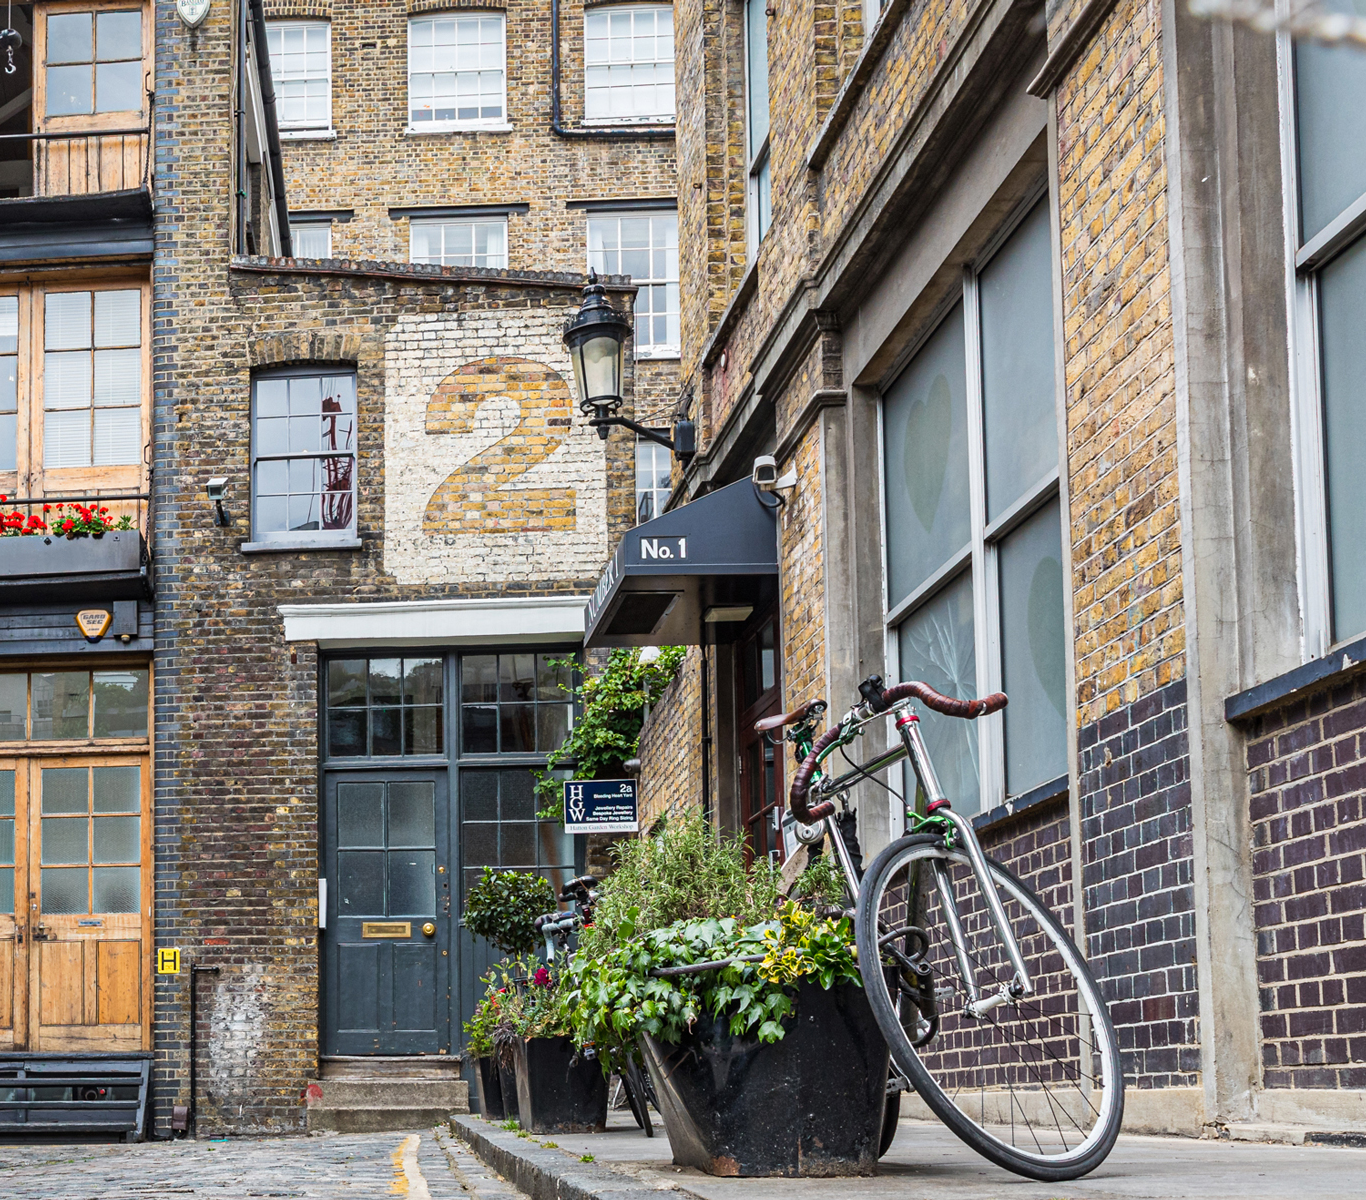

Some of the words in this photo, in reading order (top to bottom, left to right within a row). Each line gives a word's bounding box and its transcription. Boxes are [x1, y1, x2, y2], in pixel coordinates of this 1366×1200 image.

[422, 357, 577, 535] 2
[641, 538, 674, 559] No.
[678, 538, 686, 558] 1
[619, 783, 633, 793] 2a
[161, 951, 177, 971] H
